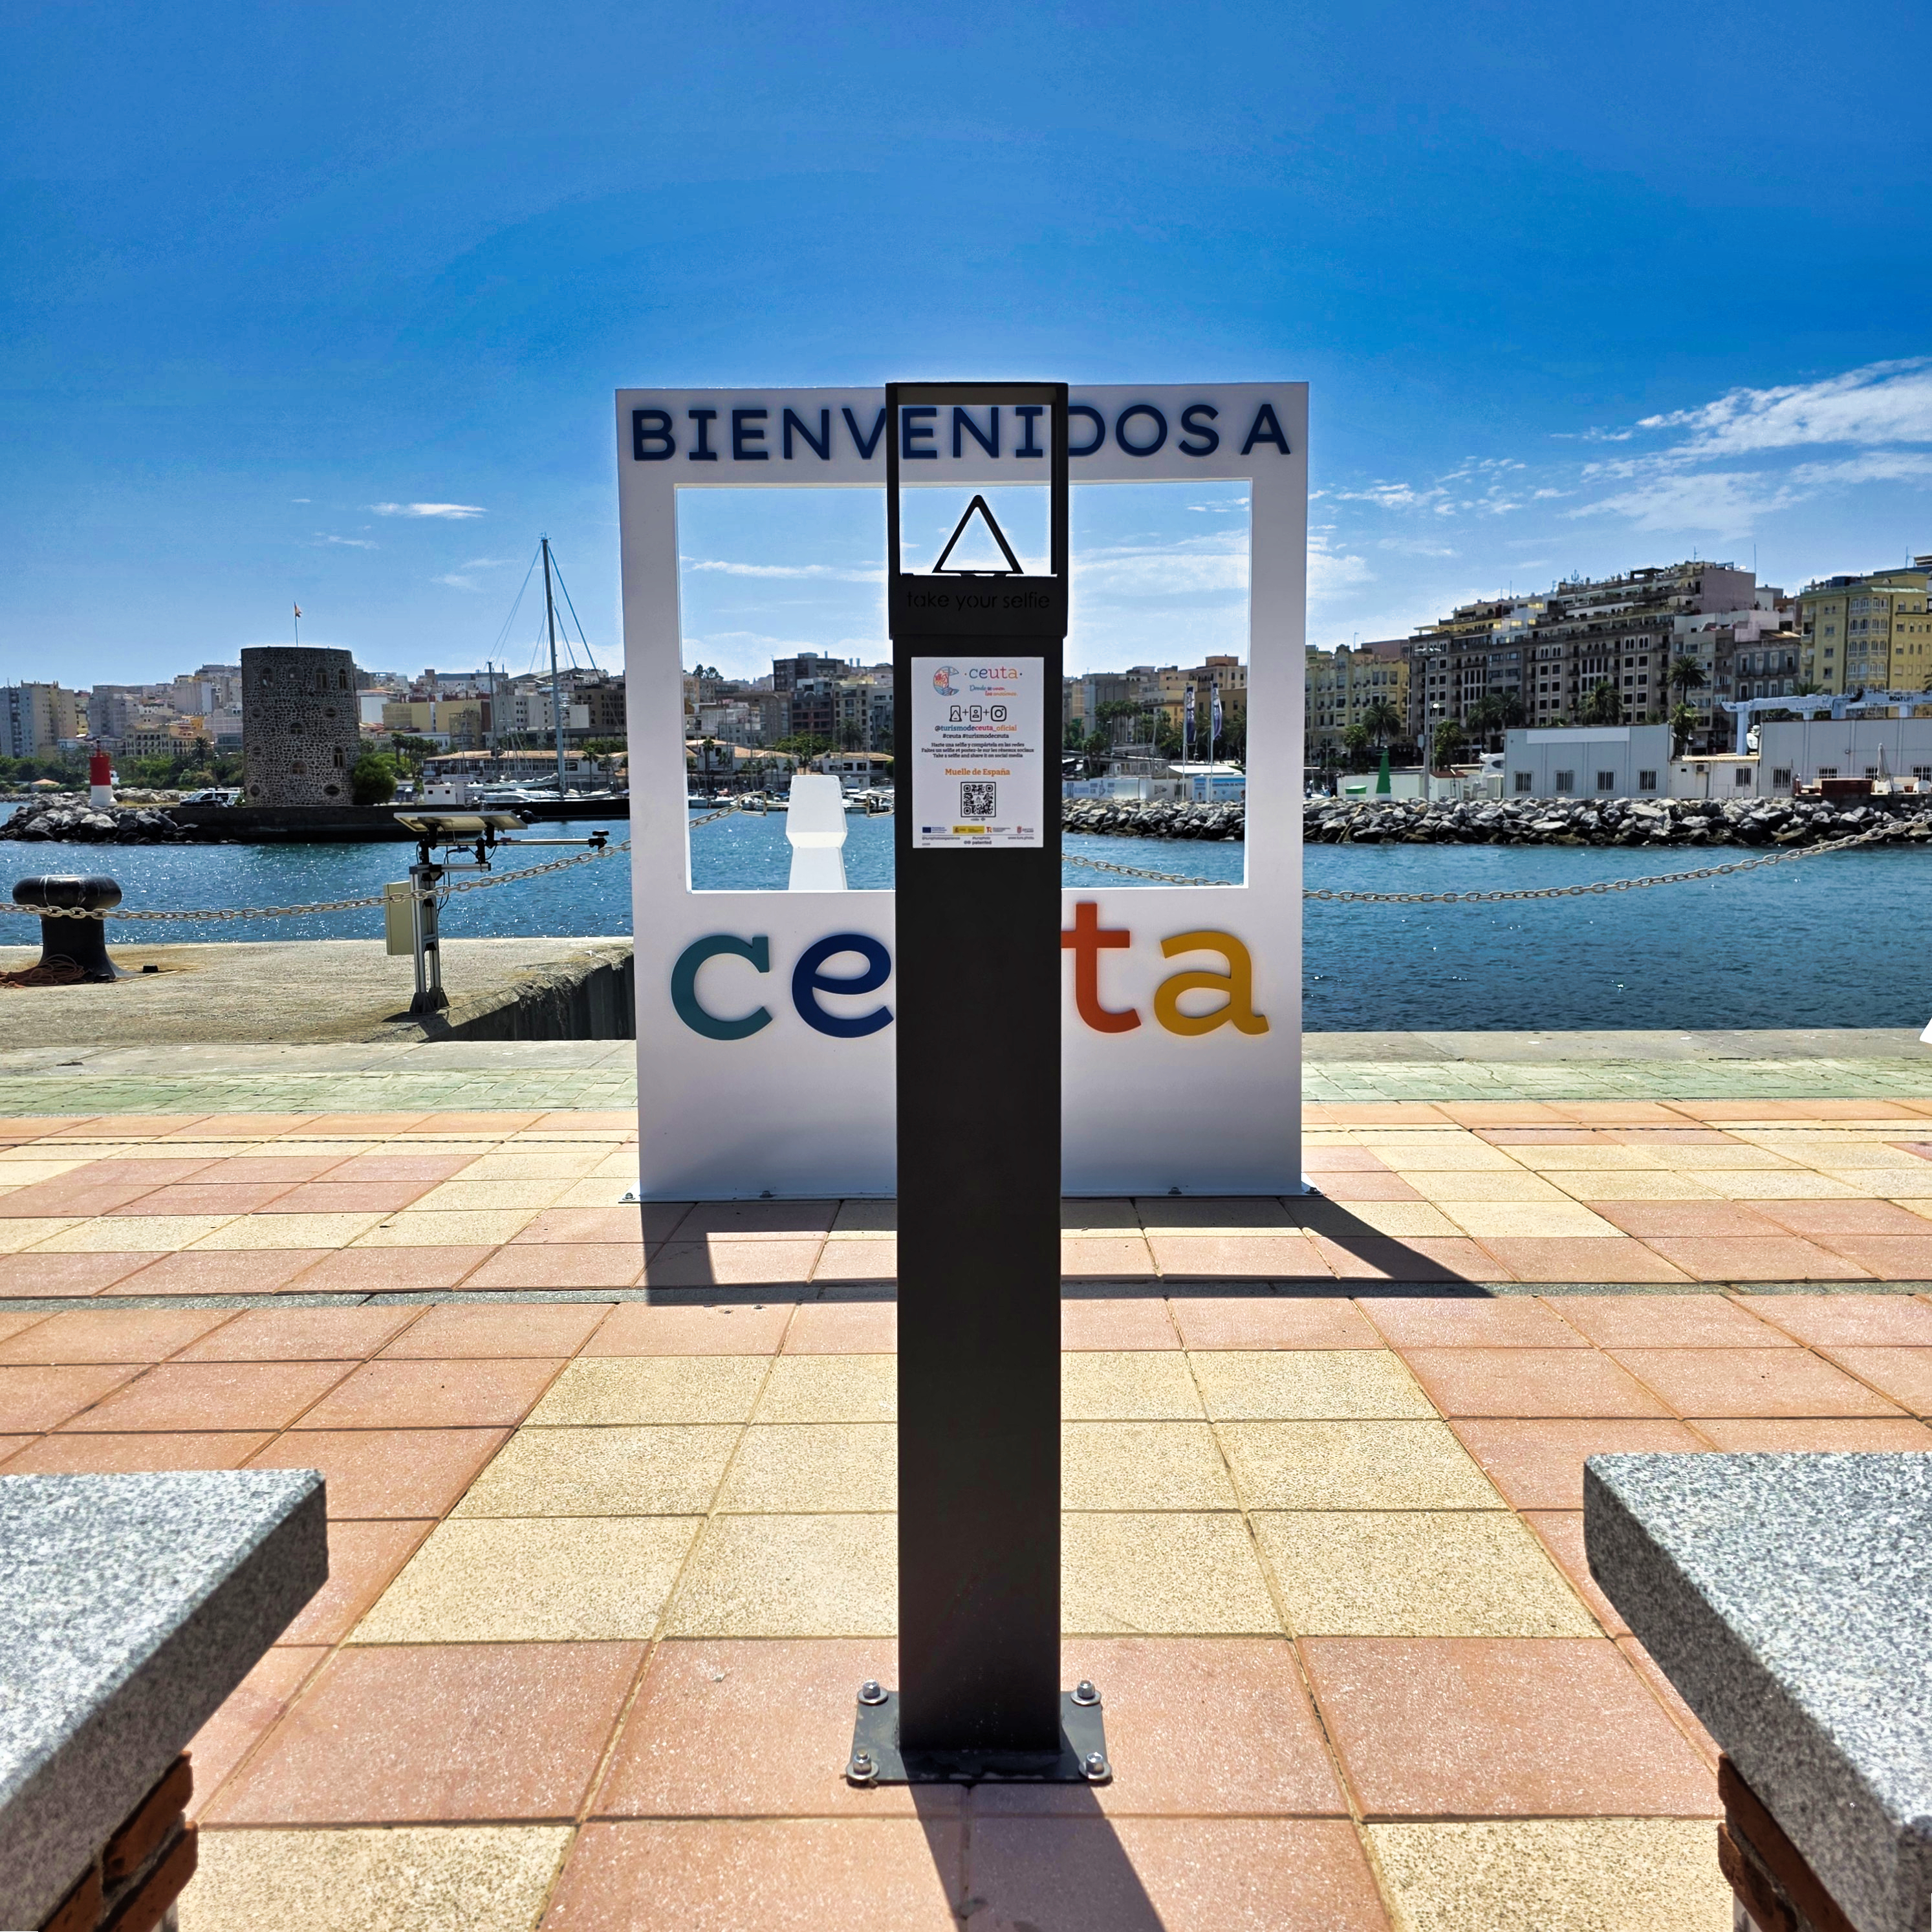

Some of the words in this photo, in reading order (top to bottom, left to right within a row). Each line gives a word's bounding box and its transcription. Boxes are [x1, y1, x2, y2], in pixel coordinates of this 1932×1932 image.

[632, 404, 1220, 461] BIENVENIDOS
[1241, 404, 1292, 456] A
[907, 591, 950, 608] take
[955, 594, 998, 611] your
[1003, 591, 1050, 609] selfie
[969, 666, 1019, 679] ceuta
[982, 768, 1010, 777] España
[671, 902, 1270, 1041] ceta
